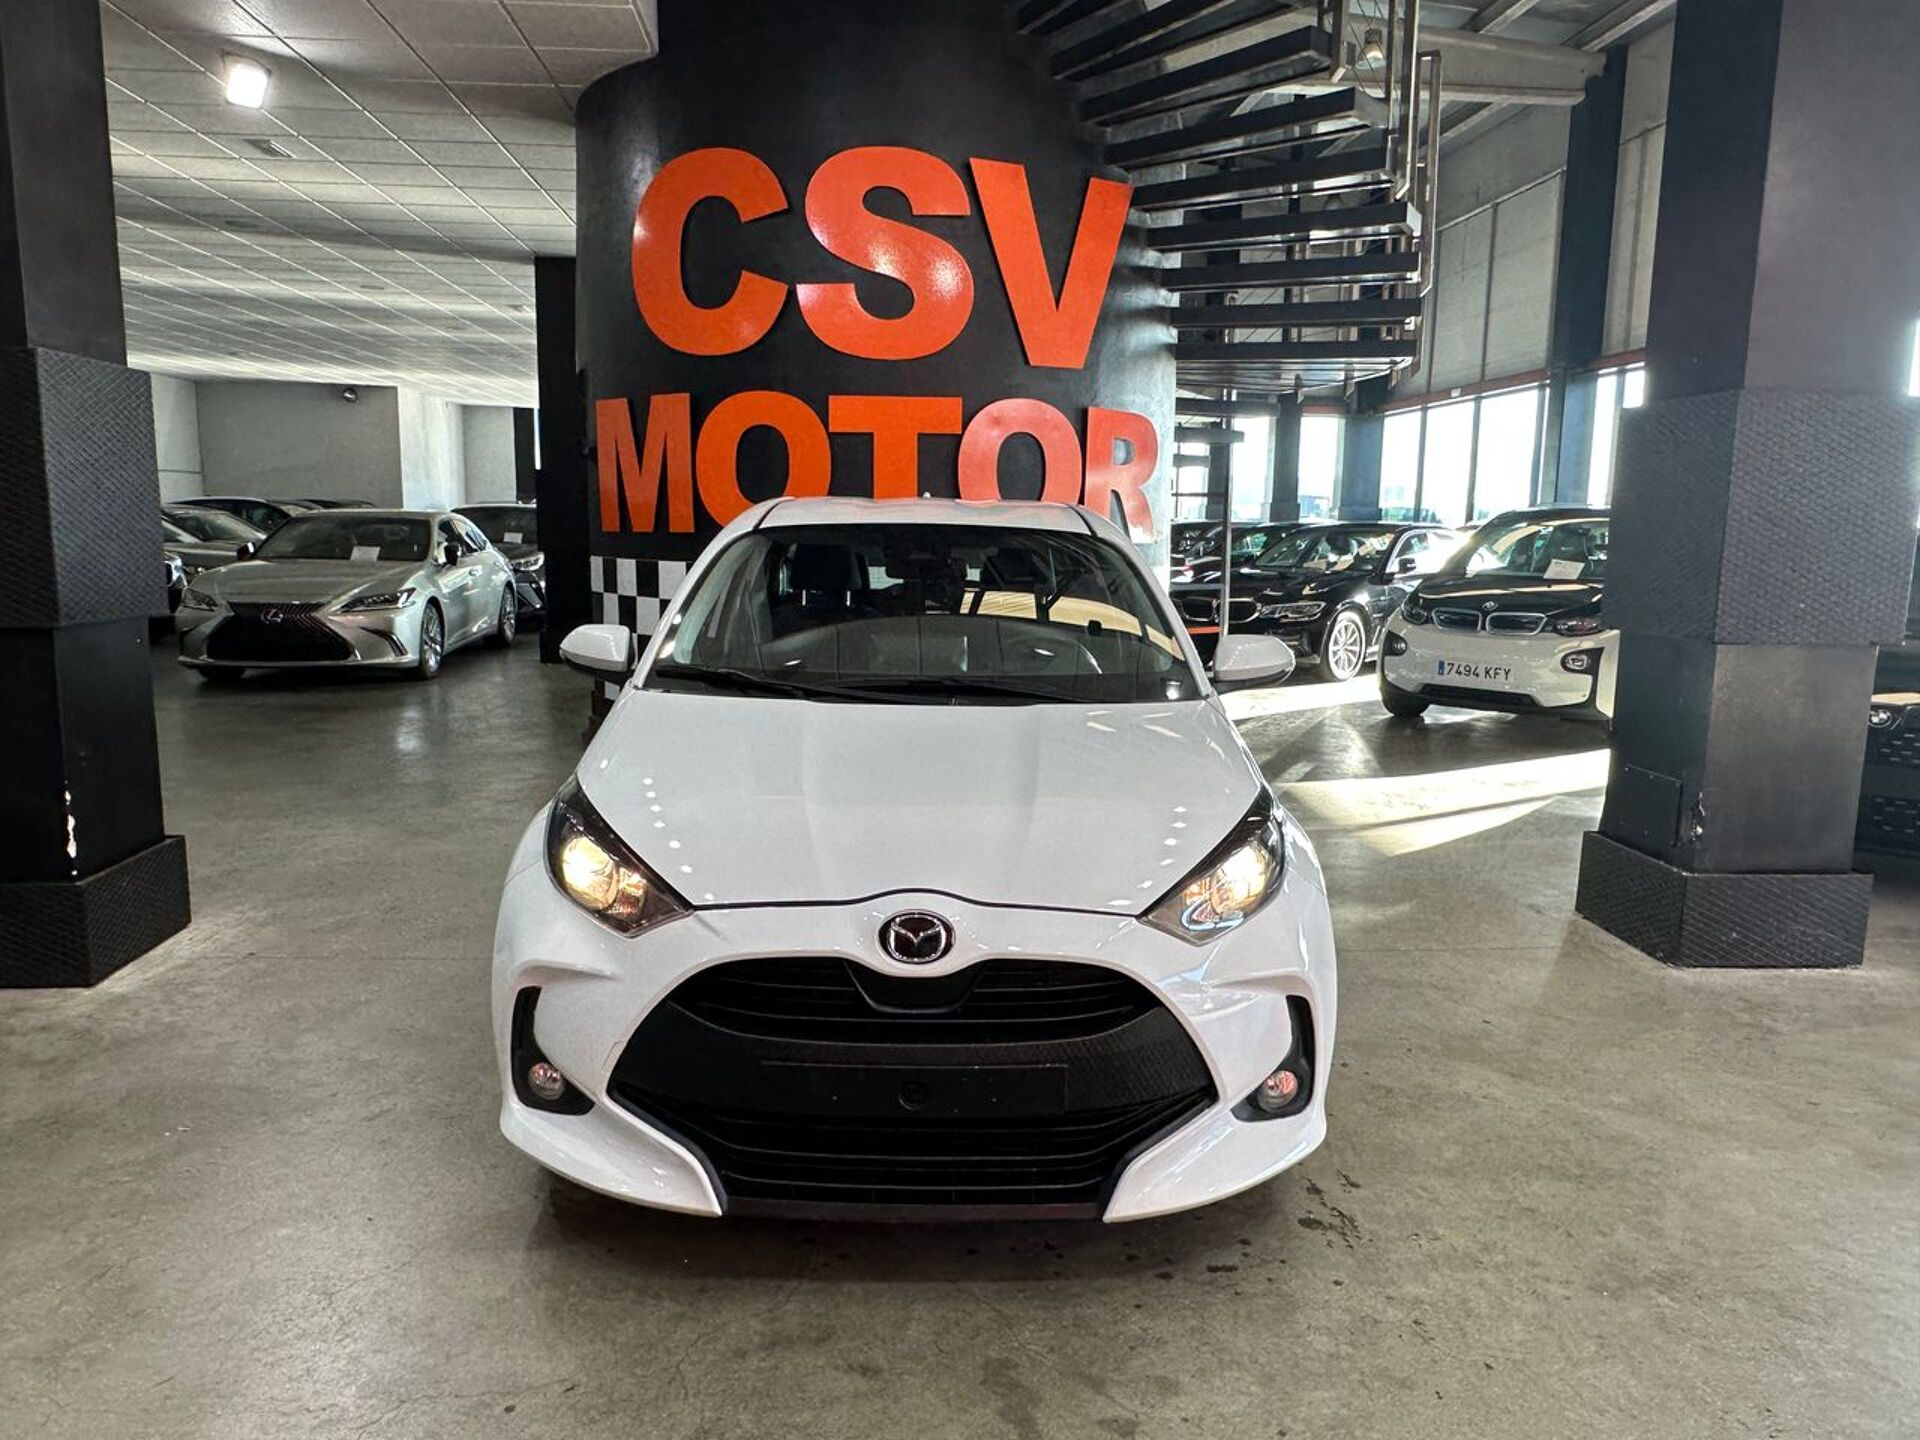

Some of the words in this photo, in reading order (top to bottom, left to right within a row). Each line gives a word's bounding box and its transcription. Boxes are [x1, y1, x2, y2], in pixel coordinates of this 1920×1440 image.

[632, 146, 1133, 369] CSV
[595, 391, 1158, 543] MOTOR
[1447, 663, 1480, 678] 7494
[1484, 666, 1512, 680] KFY
